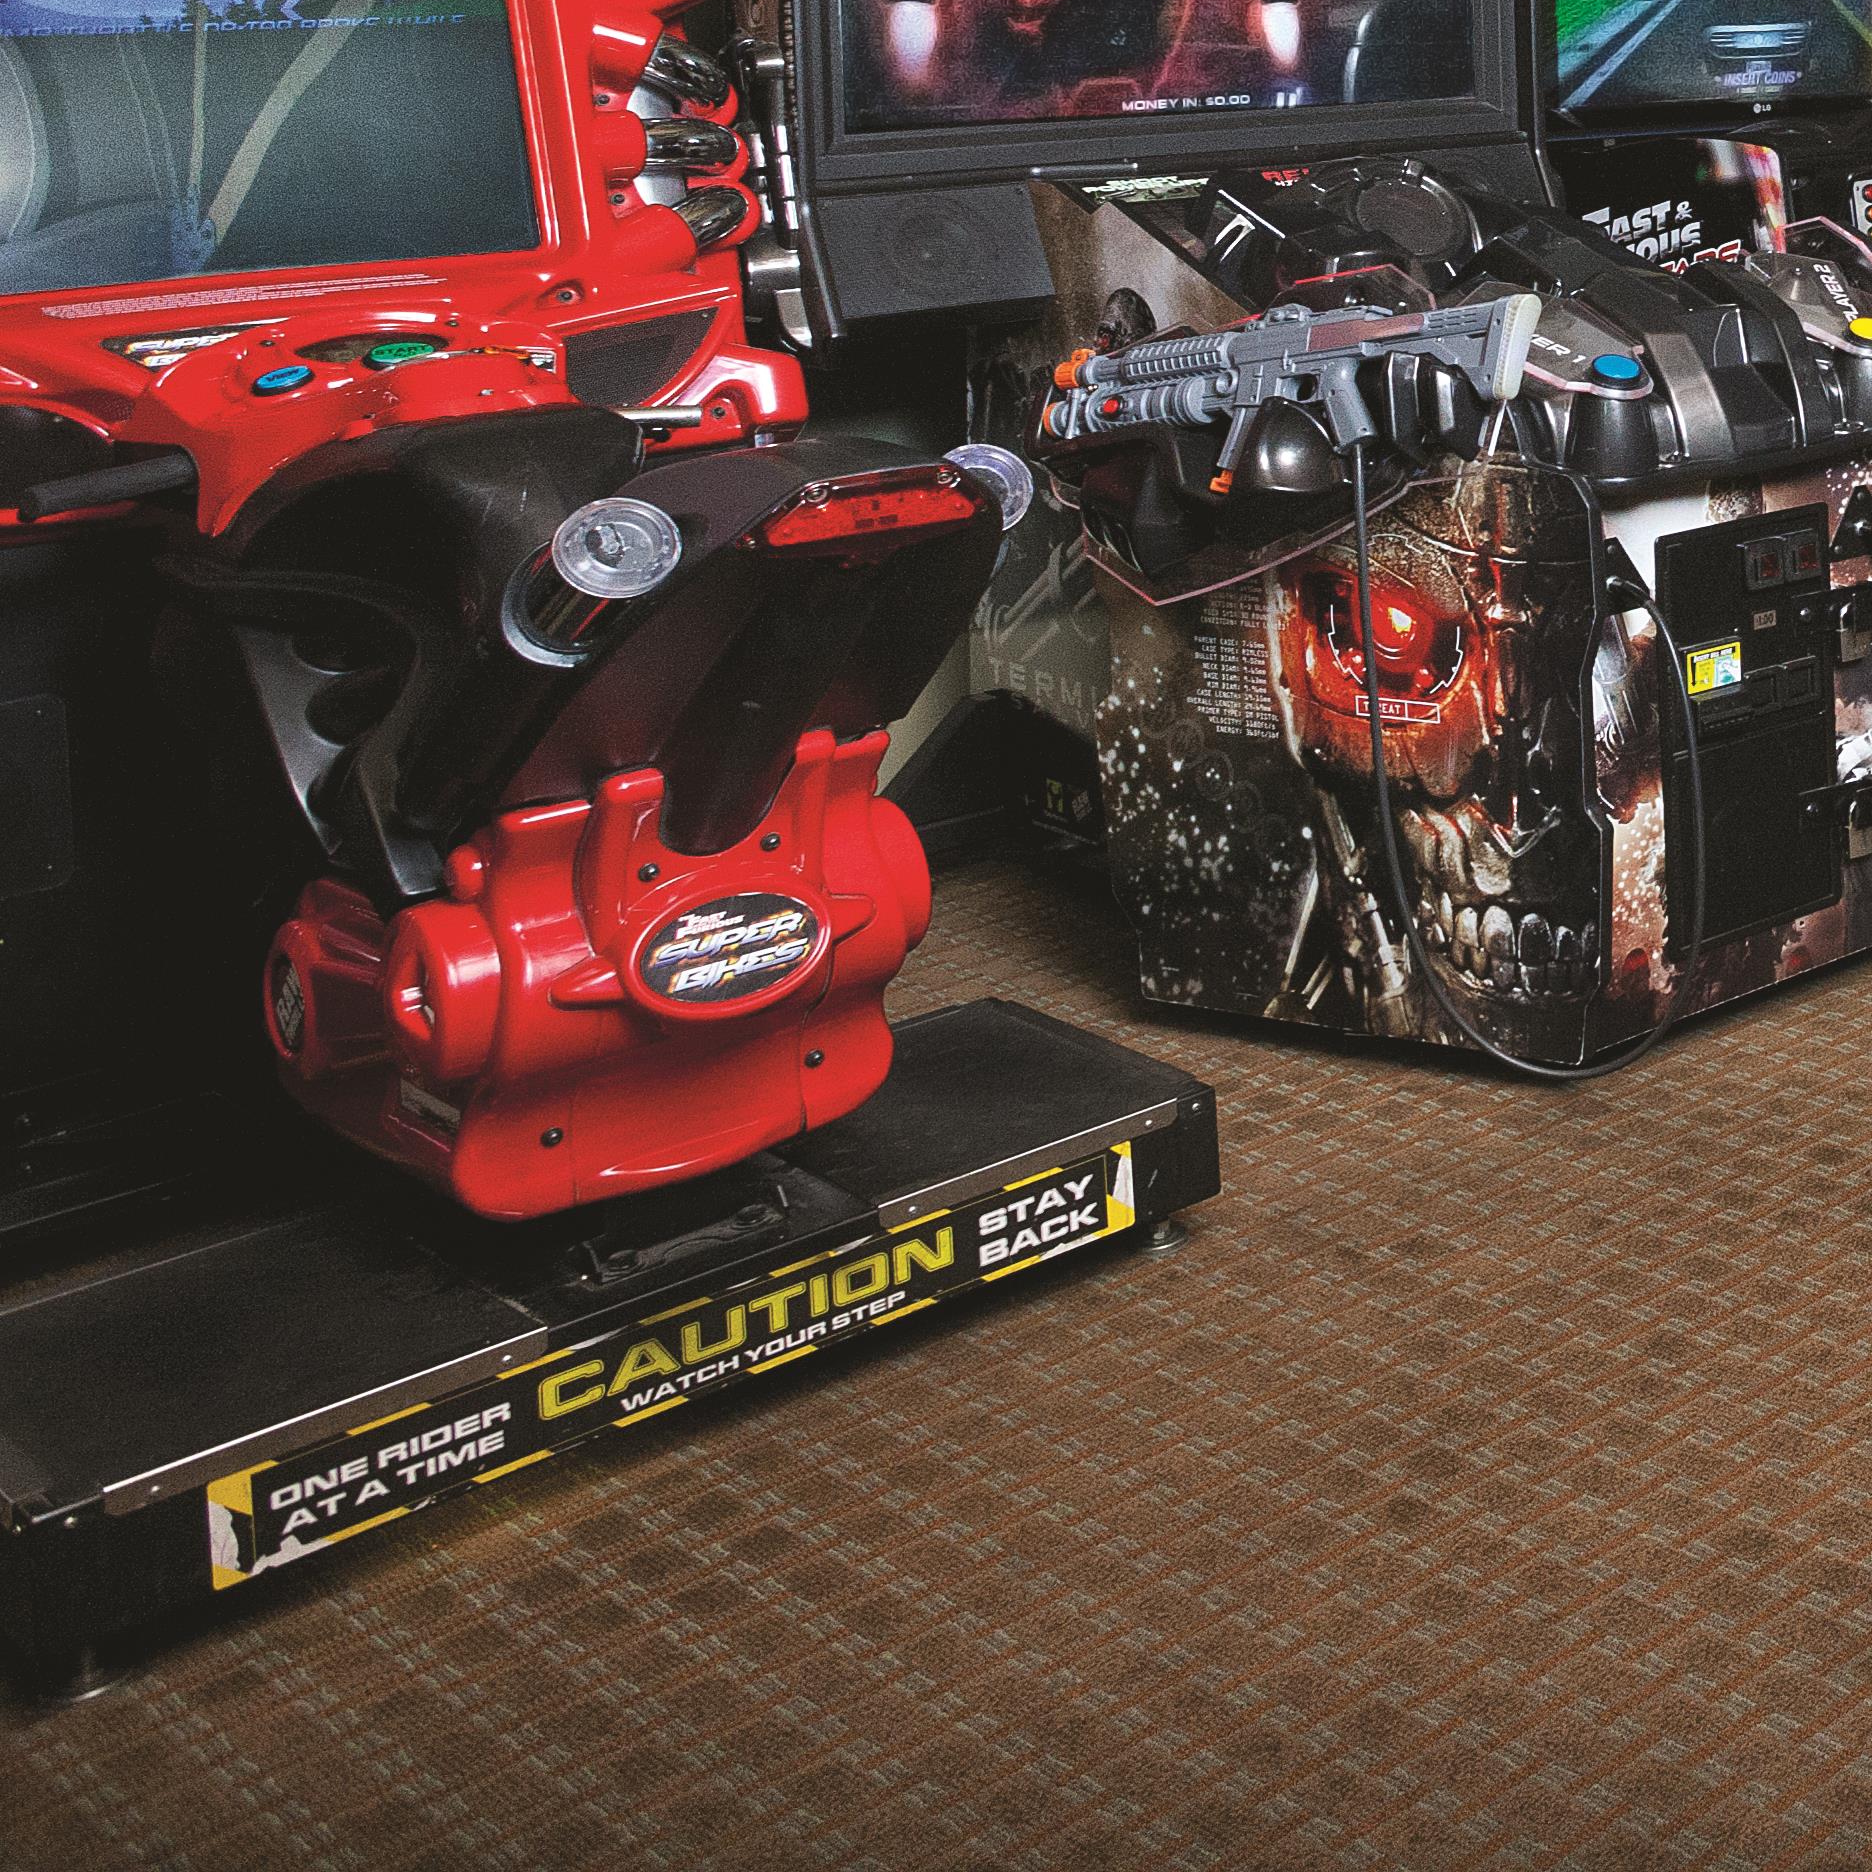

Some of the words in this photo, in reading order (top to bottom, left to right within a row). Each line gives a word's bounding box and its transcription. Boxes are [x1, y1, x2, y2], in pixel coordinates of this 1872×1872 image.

[1122, 98, 1177, 112] MONEY
[1205, 94, 1250, 107] $0.00
[1724, 71, 1761, 86] INSERT
[1764, 70, 1796, 85] COINS
[651, 912, 804, 969] SUPER
[673, 937, 809, 993] BIKES
[978, 1174, 1094, 1237] STAY
[978, 1201, 1099, 1269] BACK
[538, 1226, 955, 1421] CAUTION
[620, 1355, 742, 1414] WATCH
[745, 1321, 827, 1363] YOUR
[832, 1290, 907, 1331] STEP
[270, 1455, 369, 1511] ONE
[377, 1401, 513, 1470] RIDER
[282, 1492, 349, 1536] AT
[355, 1478, 392, 1507] A
[396, 1429, 506, 1486] TIME
